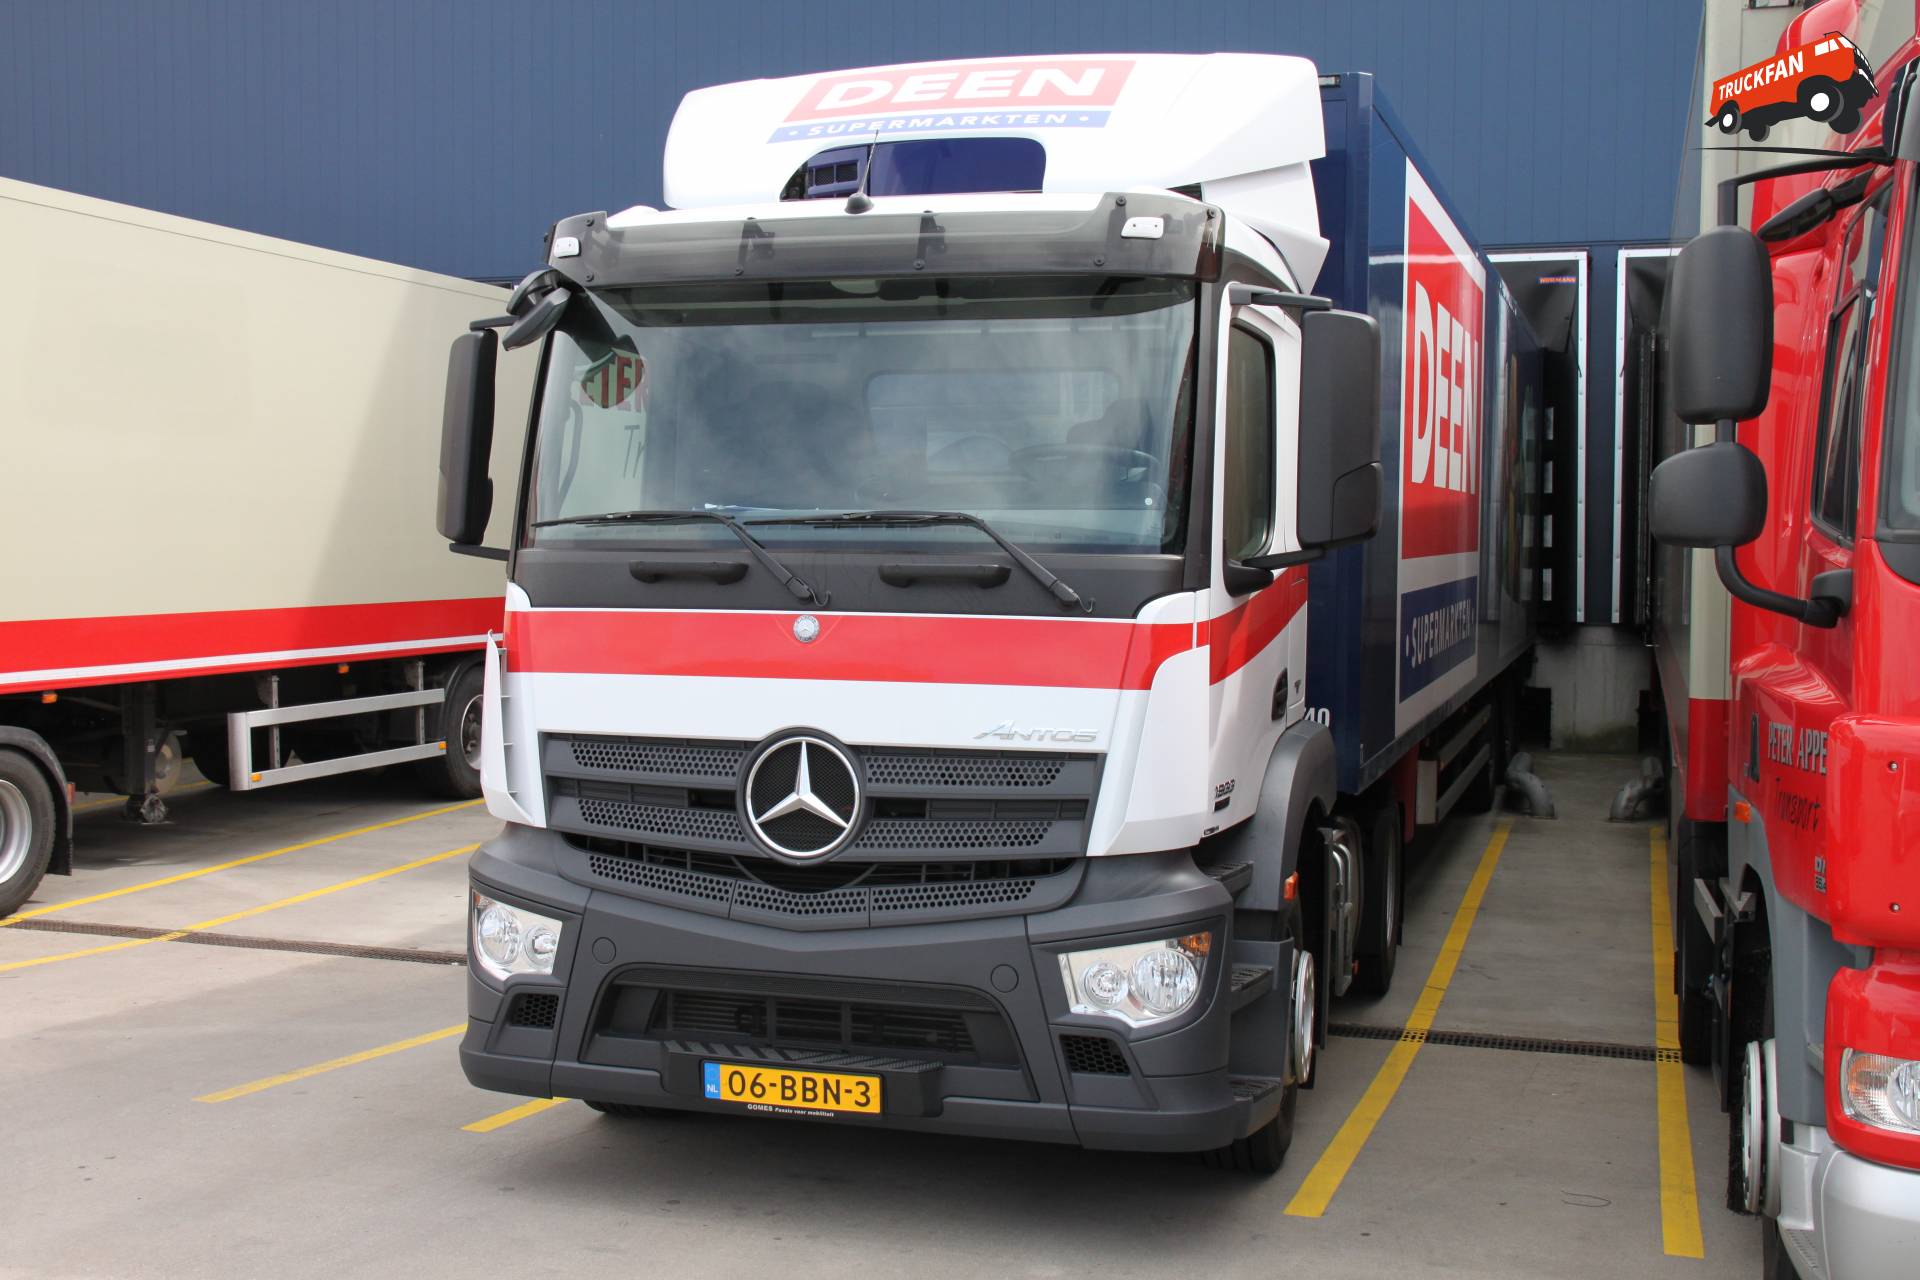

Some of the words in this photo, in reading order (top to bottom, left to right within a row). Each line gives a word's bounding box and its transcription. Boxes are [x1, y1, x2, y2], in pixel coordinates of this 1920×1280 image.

[815, 67, 1106, 111] DEEN
[808, 113, 1068, 136] SUPERMARKTEN
[1411, 280, 1478, 496] DEEN
[1411, 598, 1471, 669] SUPERMARKTEN
[1767, 721, 1793, 767] PETER
[706, 1083, 719, 1093] NL
[728, 1070, 871, 1107] 06-BBN-3
[747, 1103, 773, 1111] GOMES
